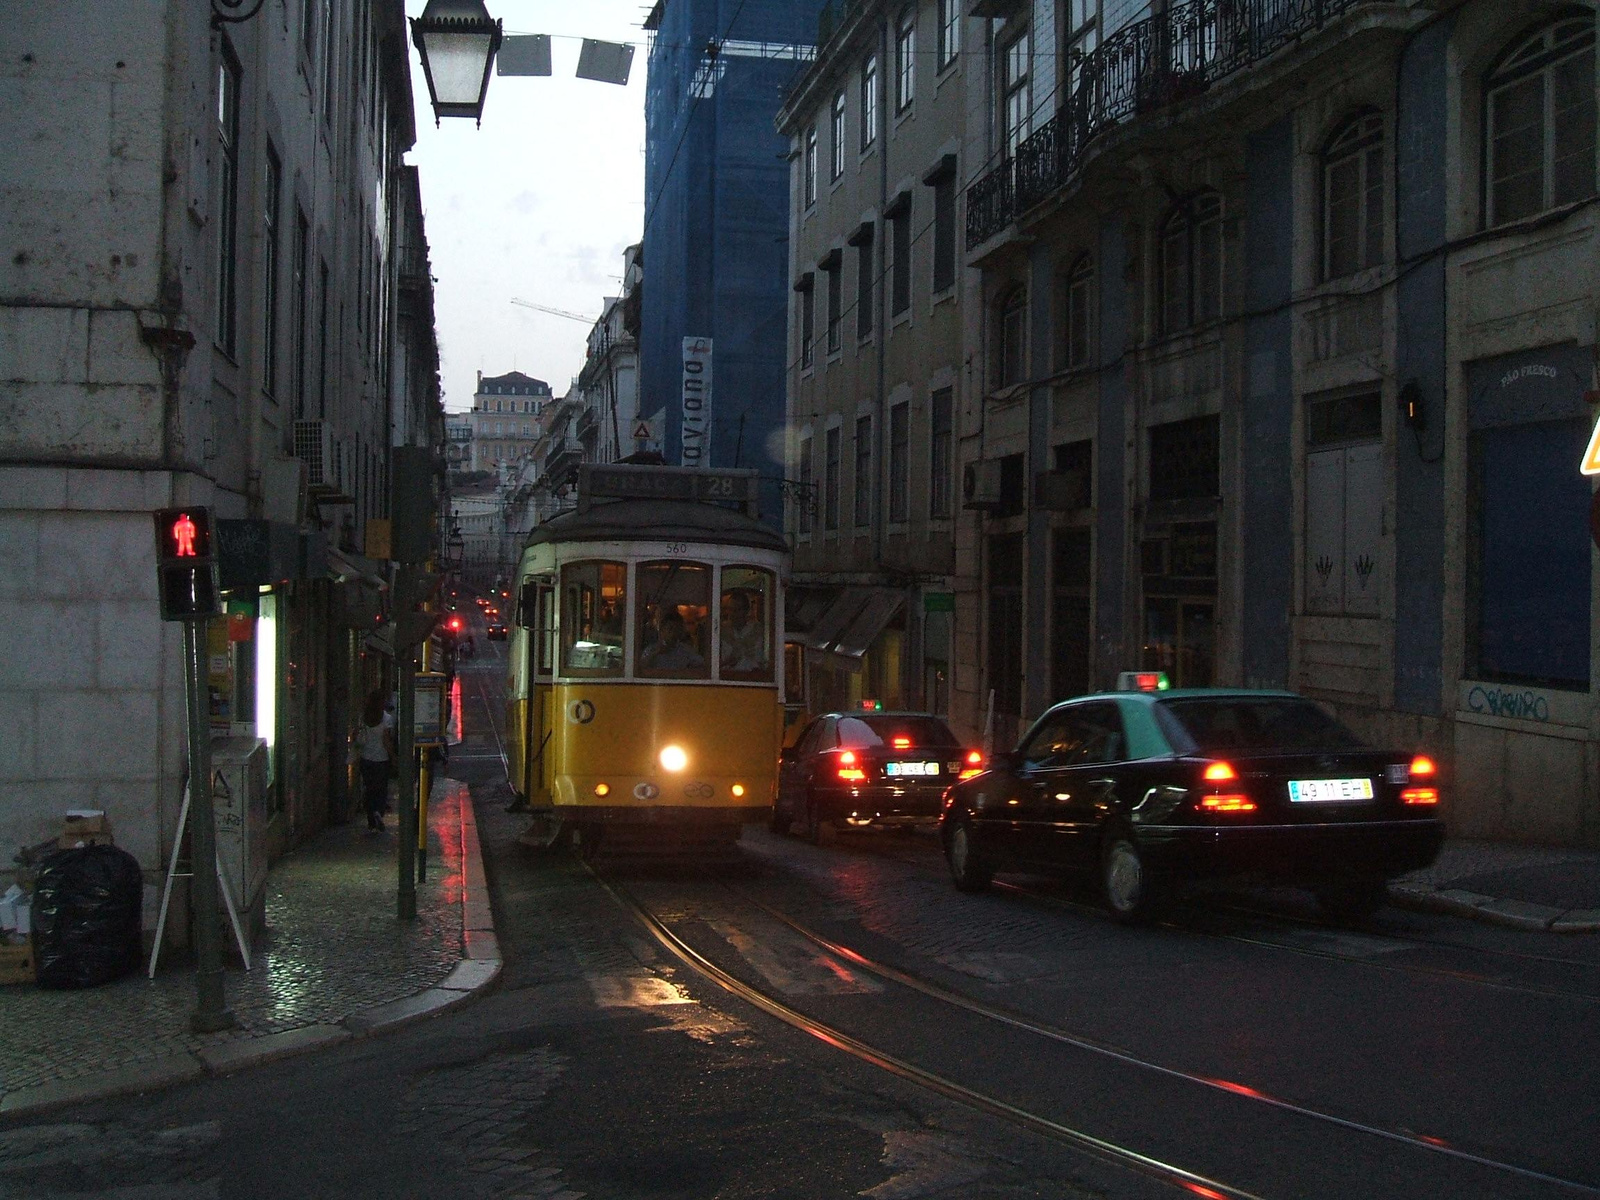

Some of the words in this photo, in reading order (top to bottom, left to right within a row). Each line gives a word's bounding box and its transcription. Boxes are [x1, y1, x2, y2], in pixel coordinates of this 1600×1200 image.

[1521, 364, 1557, 378] FRESCO
[684, 360, 703, 468] aviana
[707, 477, 733, 496] 28
[666, 543, 687, 553] 560
